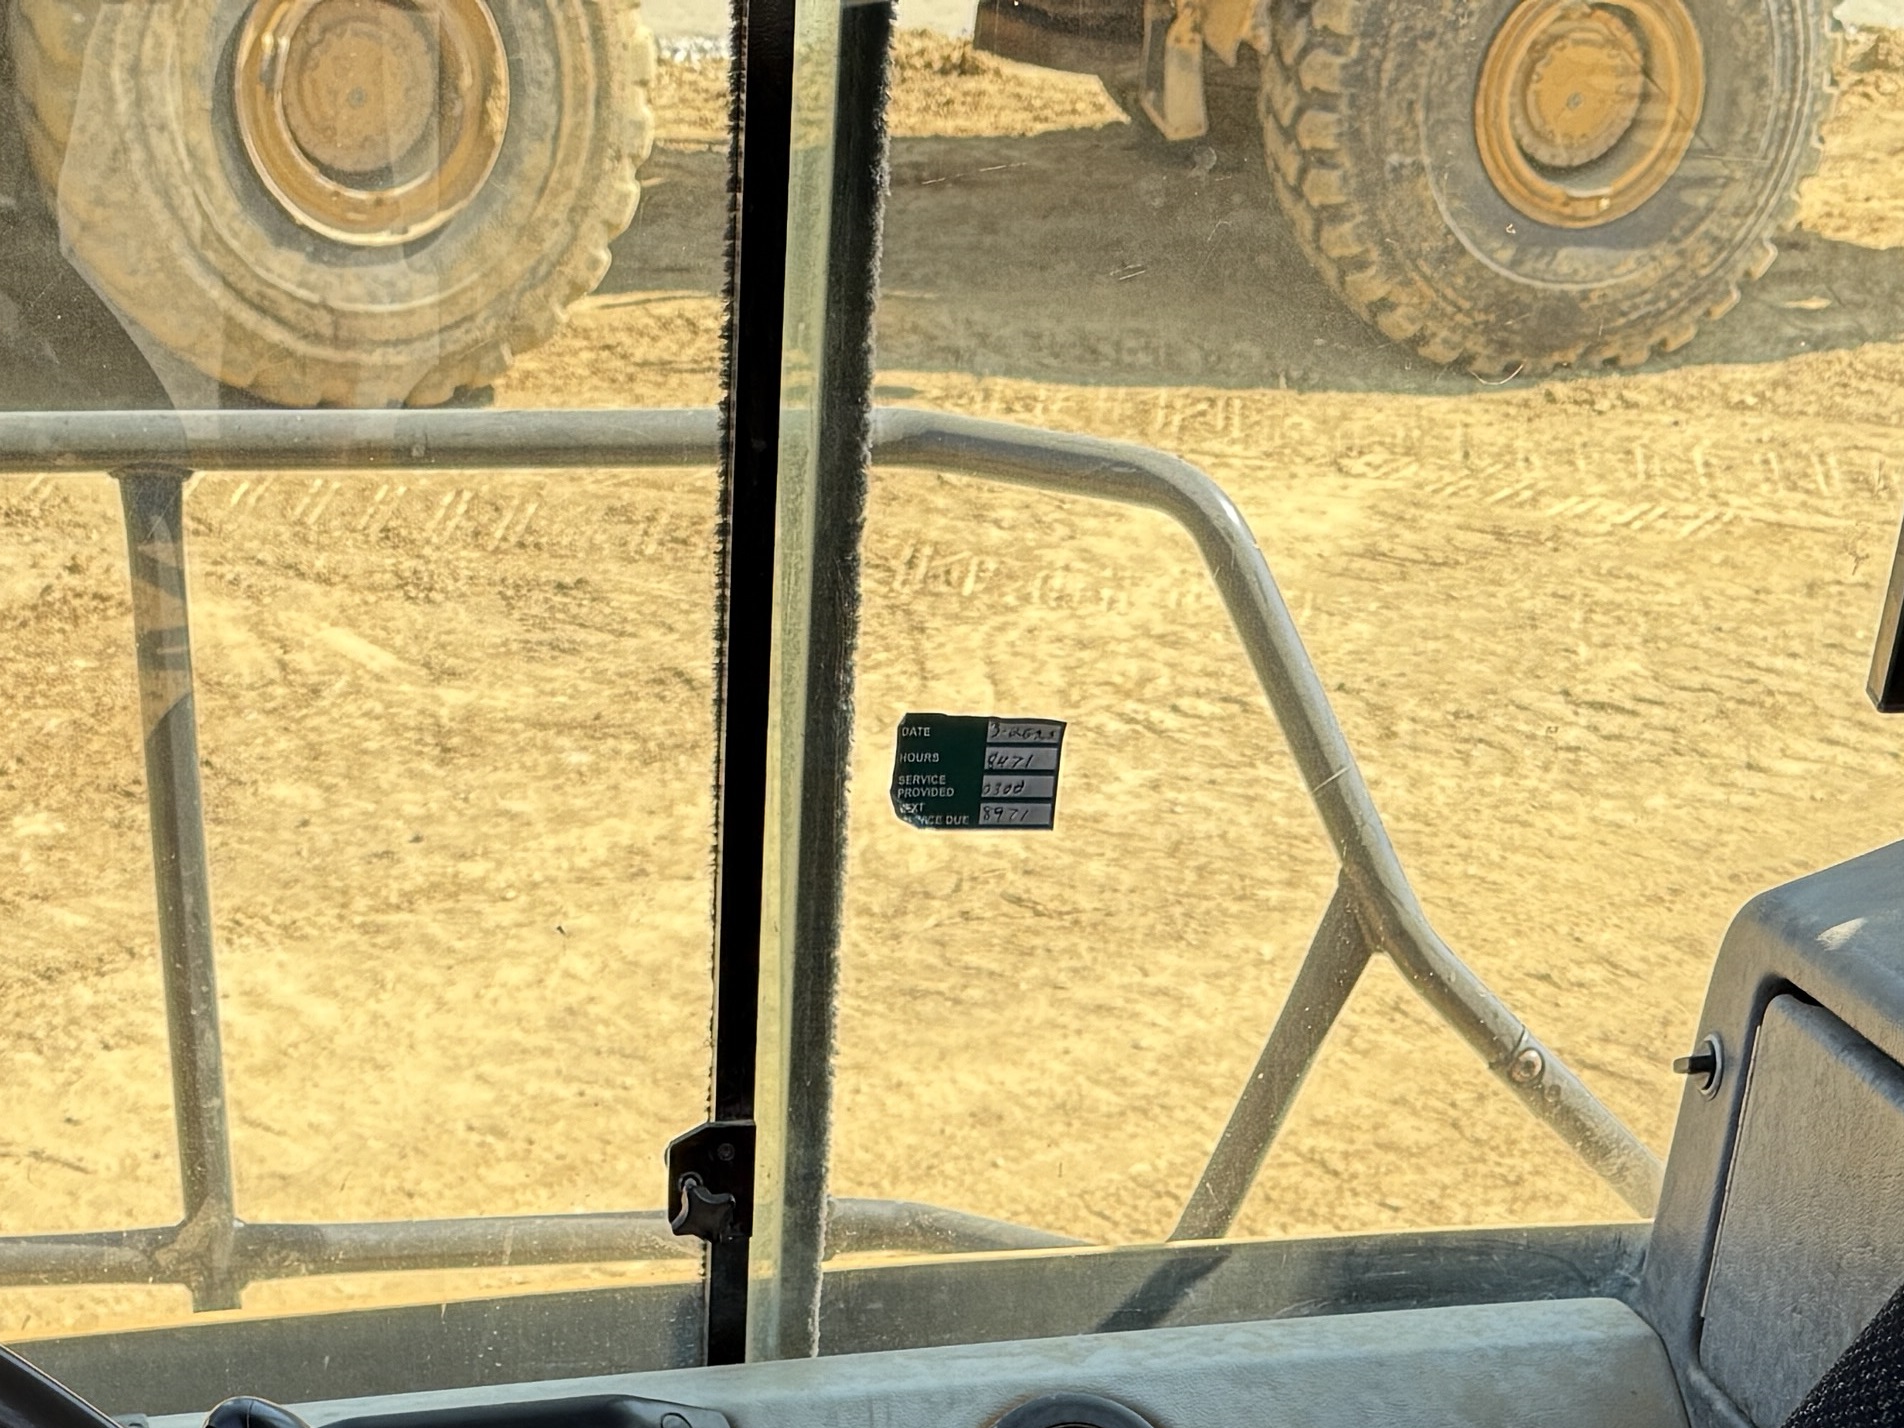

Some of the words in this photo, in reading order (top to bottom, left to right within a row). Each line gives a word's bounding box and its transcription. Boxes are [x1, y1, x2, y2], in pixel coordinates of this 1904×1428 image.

[902, 727, 931, 737] DATE
[899, 752, 940, 763] HOURS
[898, 775, 946, 785] SERVICE
[897, 787, 955, 798] PROVIDED
[945, 815, 970, 825] DUE
